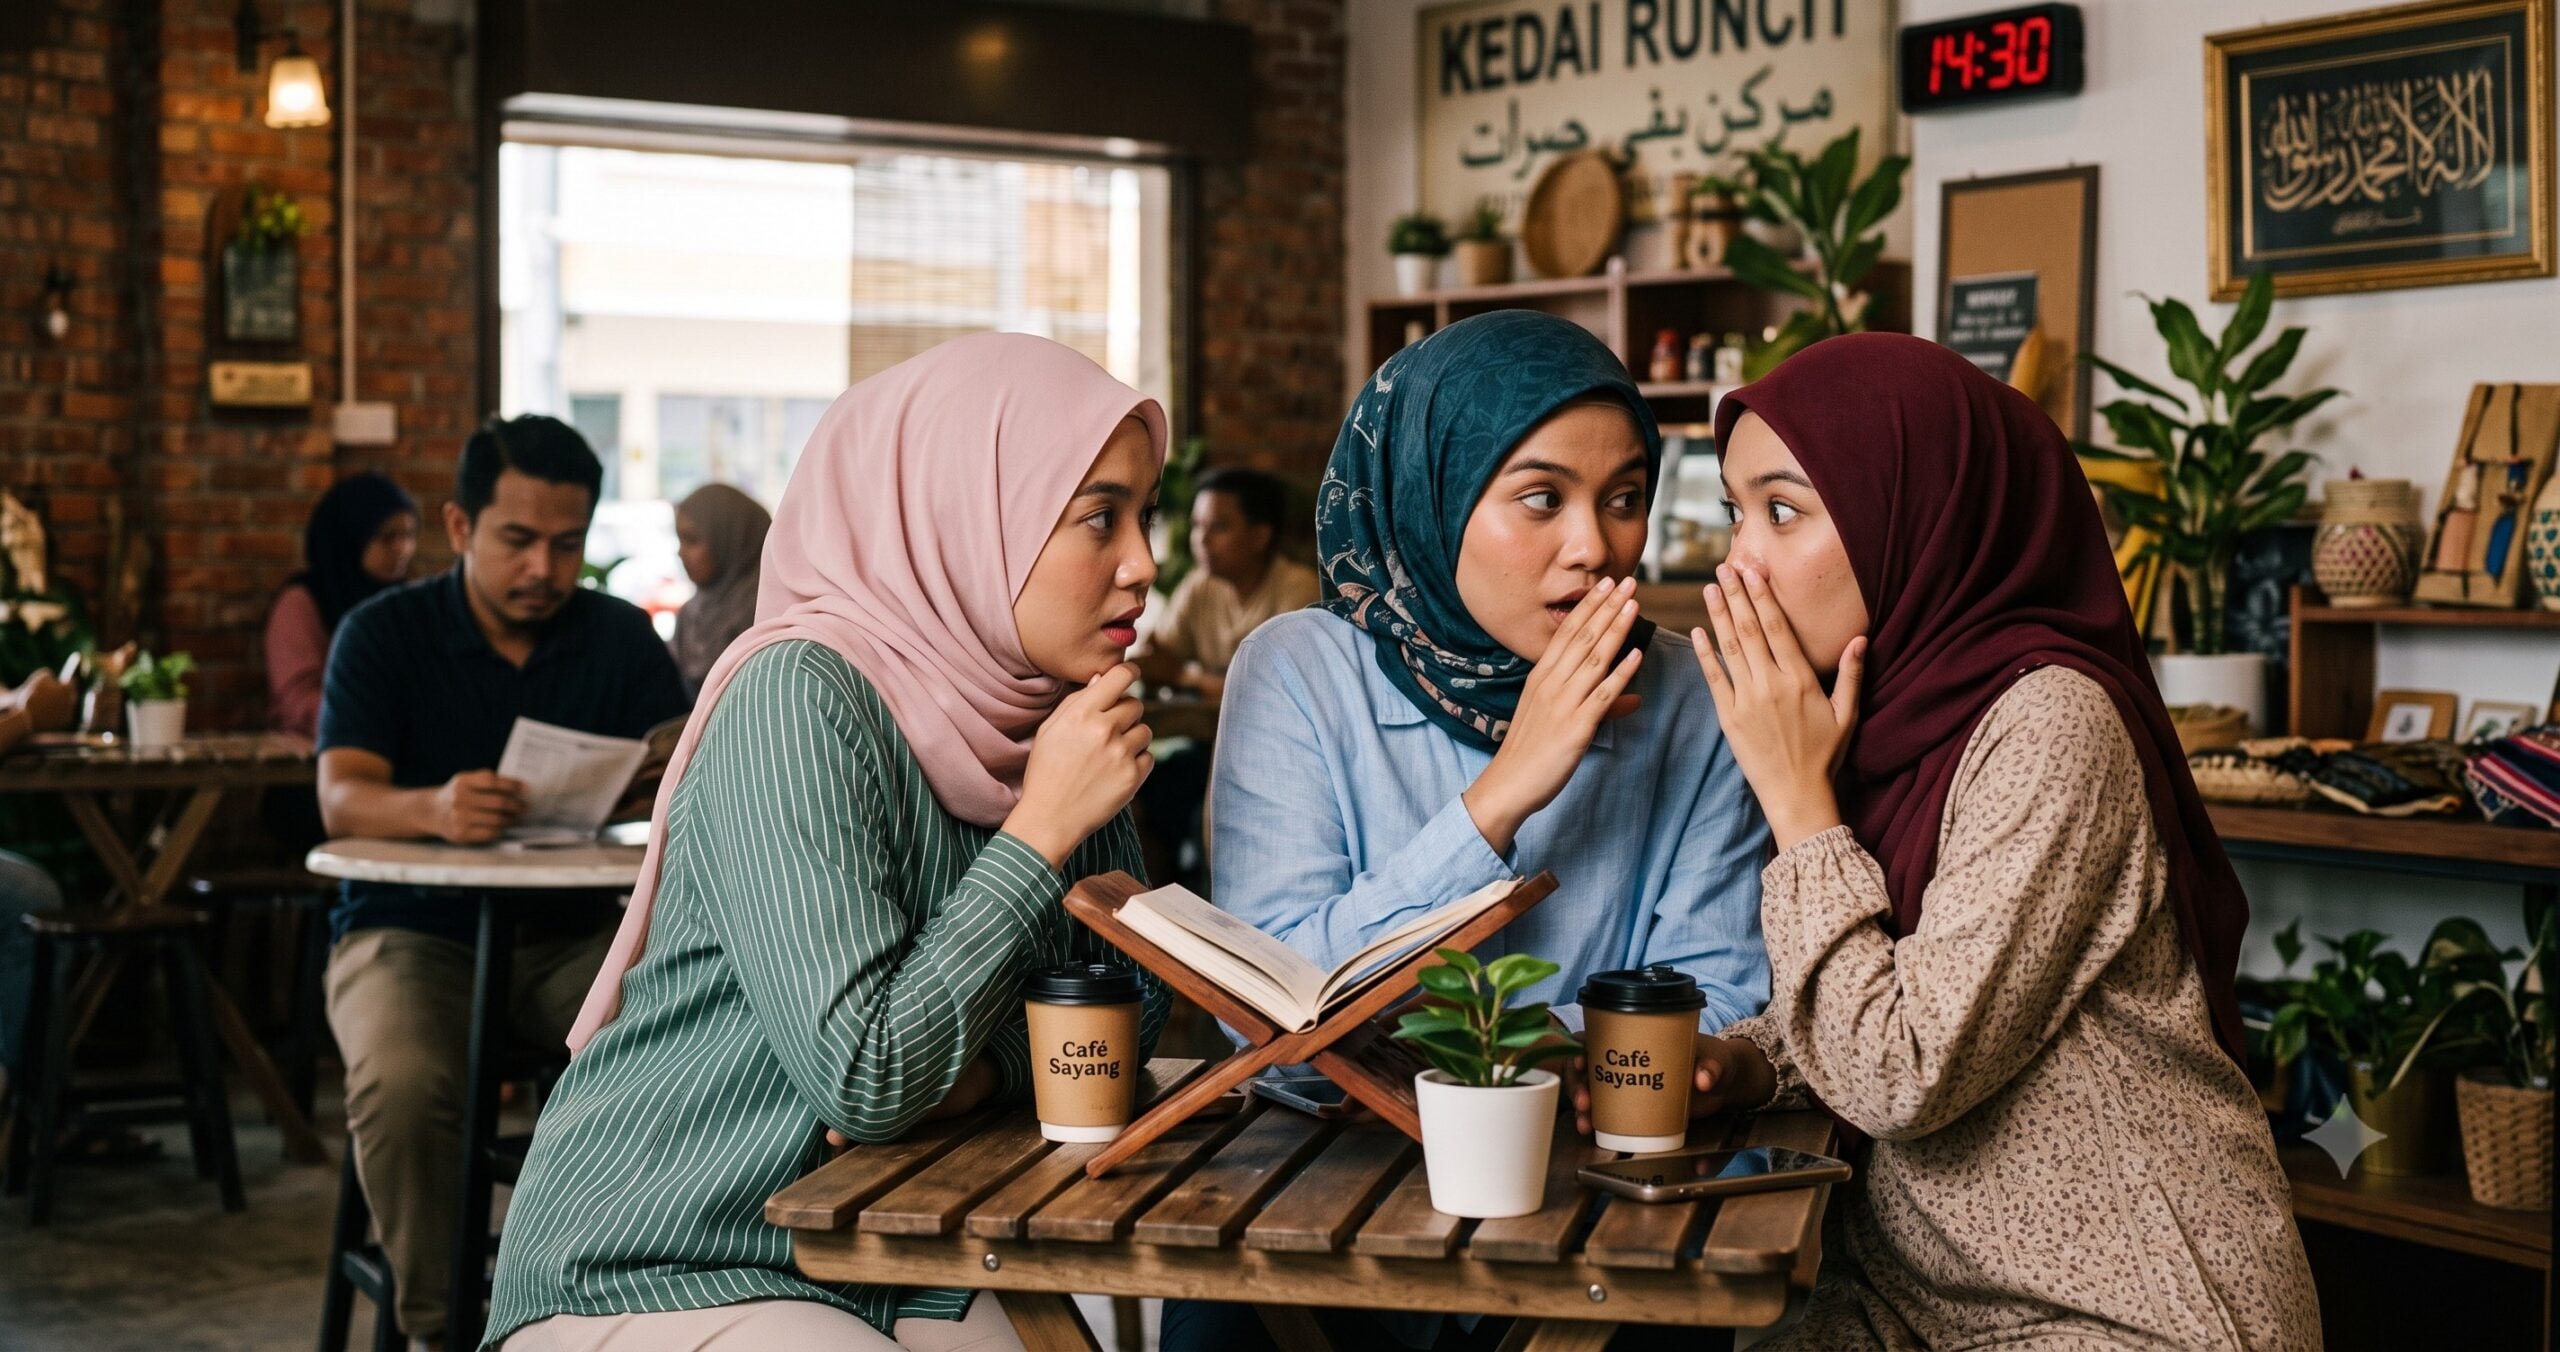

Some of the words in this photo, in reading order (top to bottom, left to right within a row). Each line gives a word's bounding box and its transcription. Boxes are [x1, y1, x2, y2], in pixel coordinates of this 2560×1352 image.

[1439, 2, 1600, 95] KEDAI
[1929, 16, 2051, 95] 14:30
[1062, 1040, 1108, 1058] Café
[1605, 1049, 1651, 1068] Café
[1049, 1058, 1121, 1080] Sayang
[1594, 1065, 1665, 1091] Sayang
